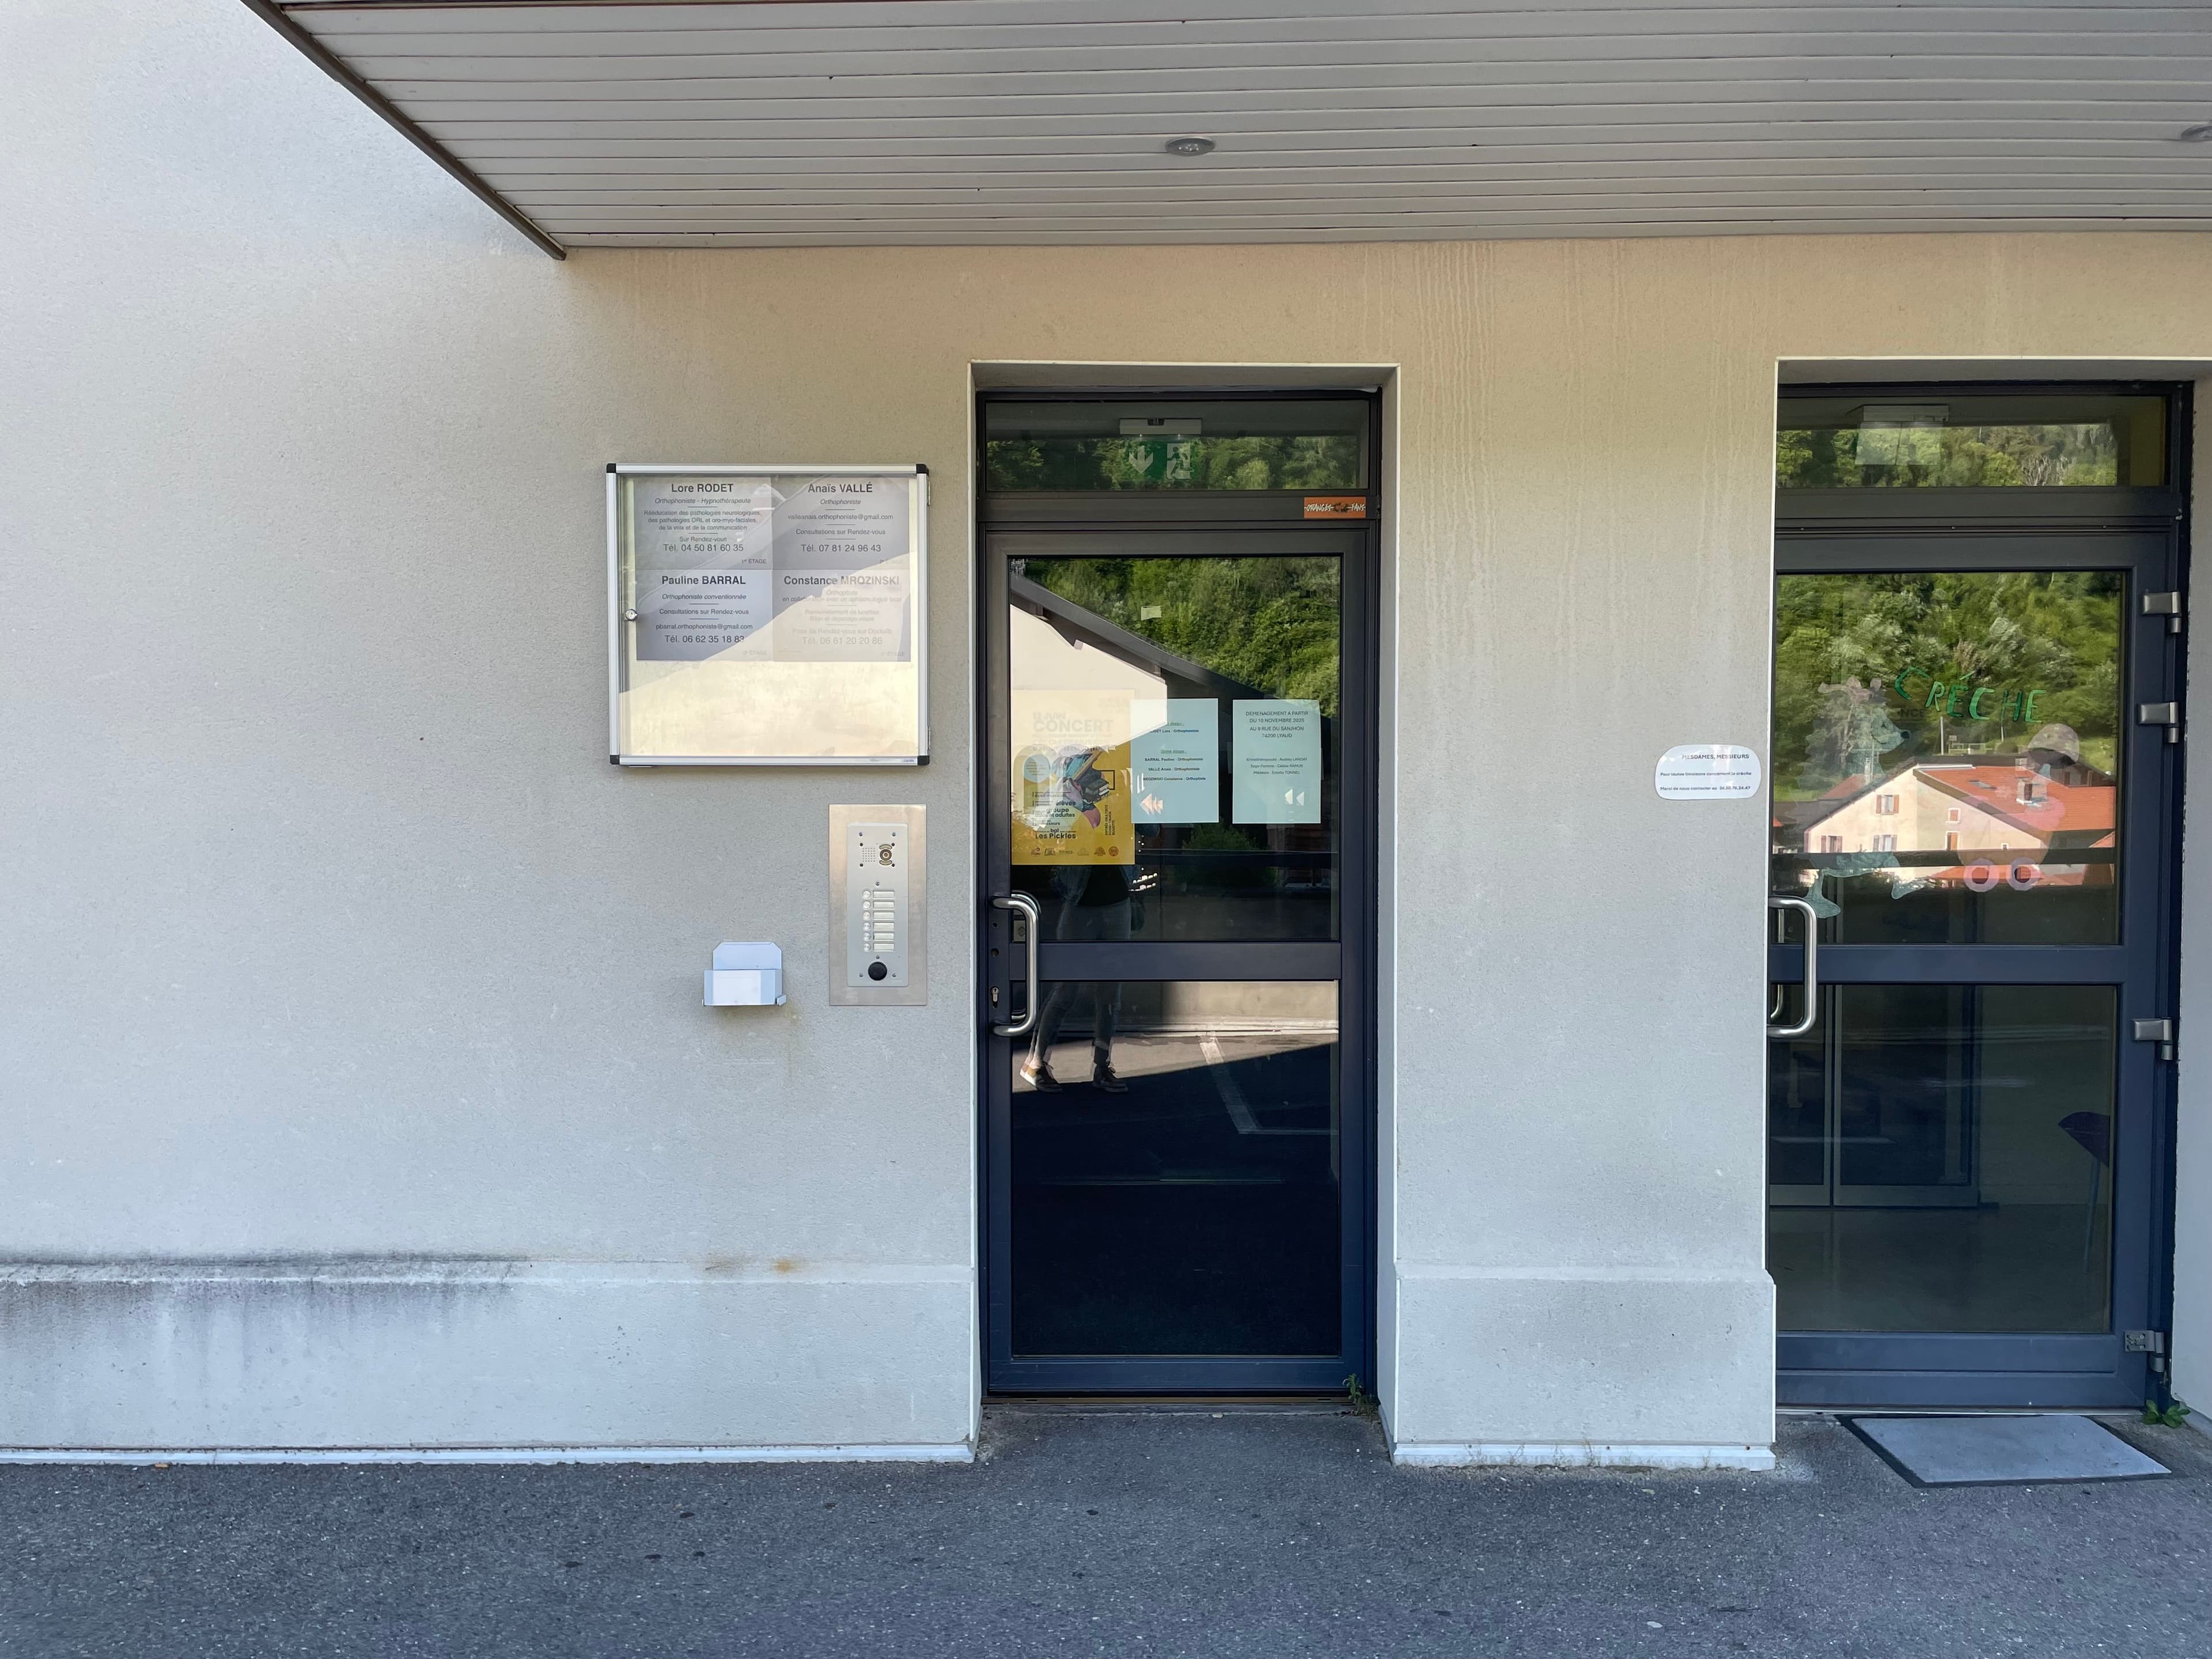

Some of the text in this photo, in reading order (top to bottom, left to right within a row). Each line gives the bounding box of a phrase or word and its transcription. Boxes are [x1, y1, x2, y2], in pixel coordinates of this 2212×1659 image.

[672, 484, 733, 492] Lore RODET
[808, 482, 873, 493] Anaïs VALLÉ
[1306, 503, 1365, 512] ORANGES FANS
[662, 576, 746, 584] Pauline BARRAL
[783, 576, 899, 585] Constance MROZINSKI
[802, 637, 882, 645] Tél. 06 61 20 20 86
[1033, 719, 1114, 732] CONCERT
